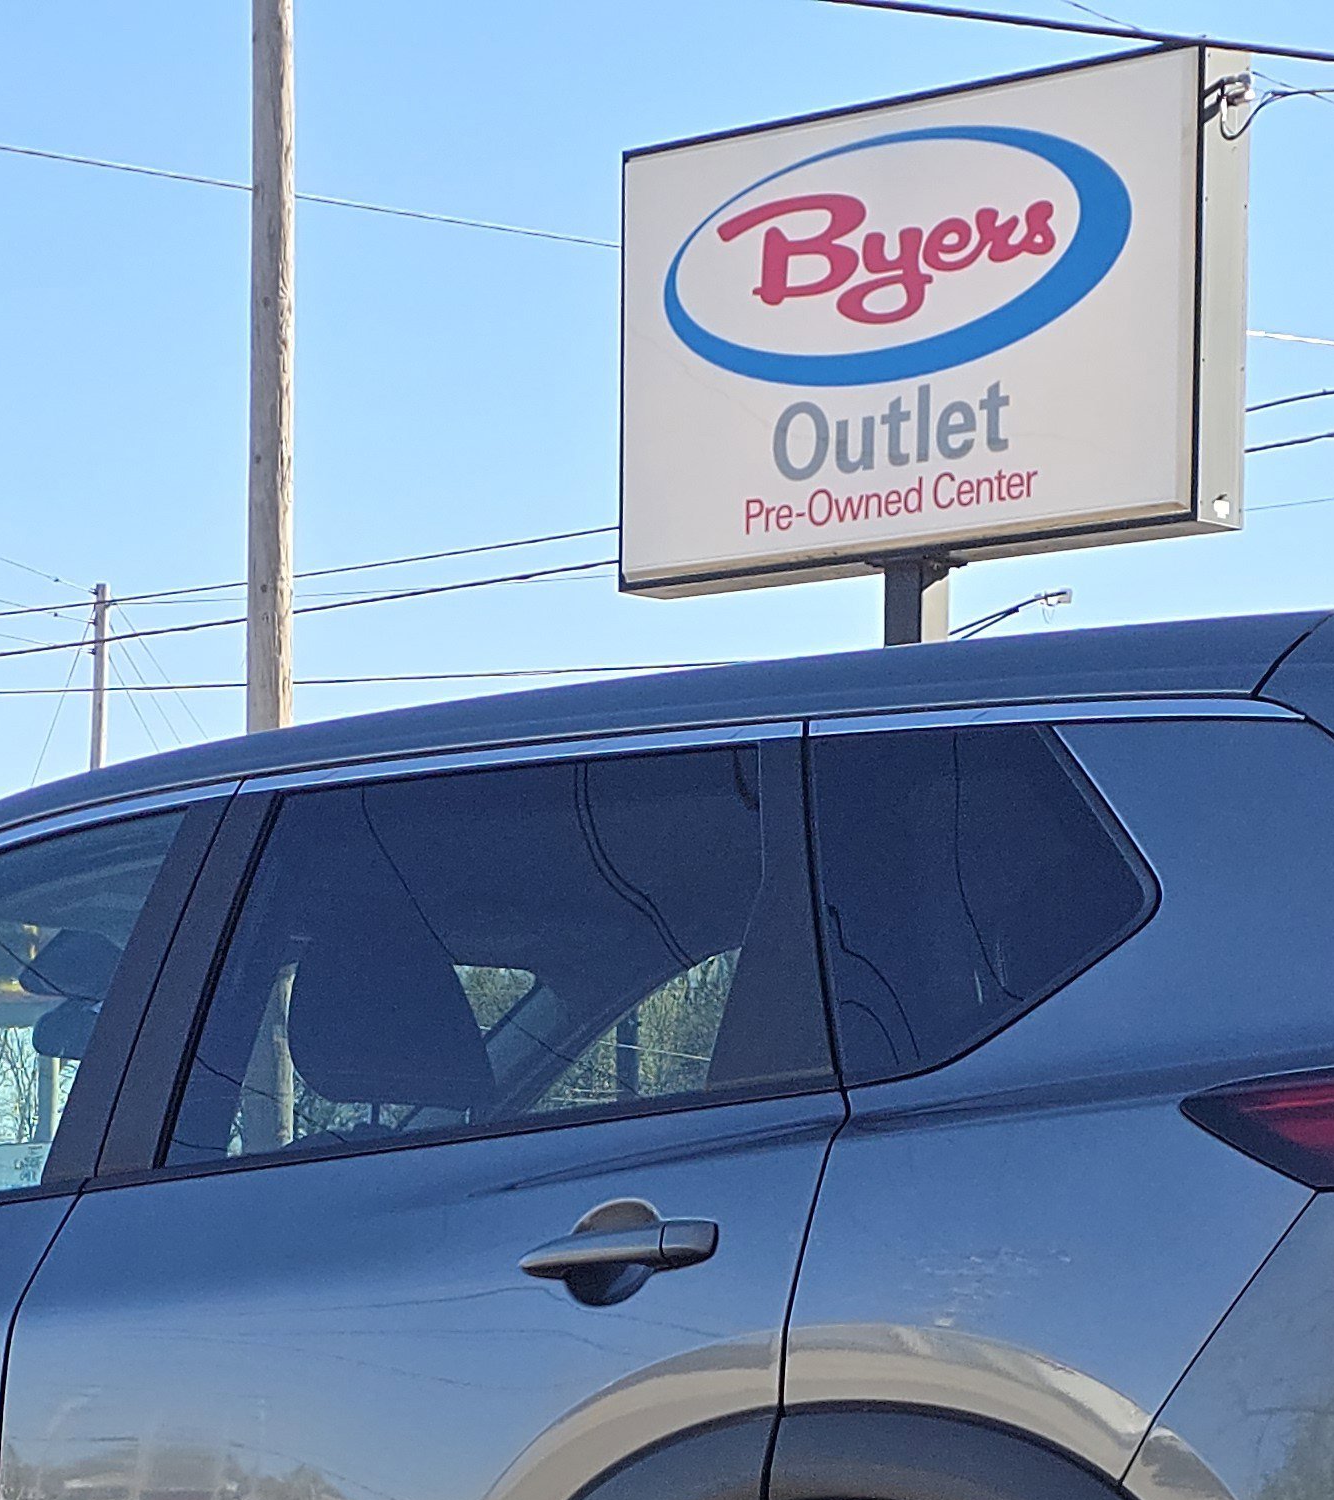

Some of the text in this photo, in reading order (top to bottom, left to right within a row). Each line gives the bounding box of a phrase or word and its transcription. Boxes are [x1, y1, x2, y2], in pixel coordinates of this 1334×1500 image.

[717, 194, 1055, 324] Byers
[773, 380, 1010, 481] Outlet
[745, 469, 1038, 535] Pre-Owned Center
